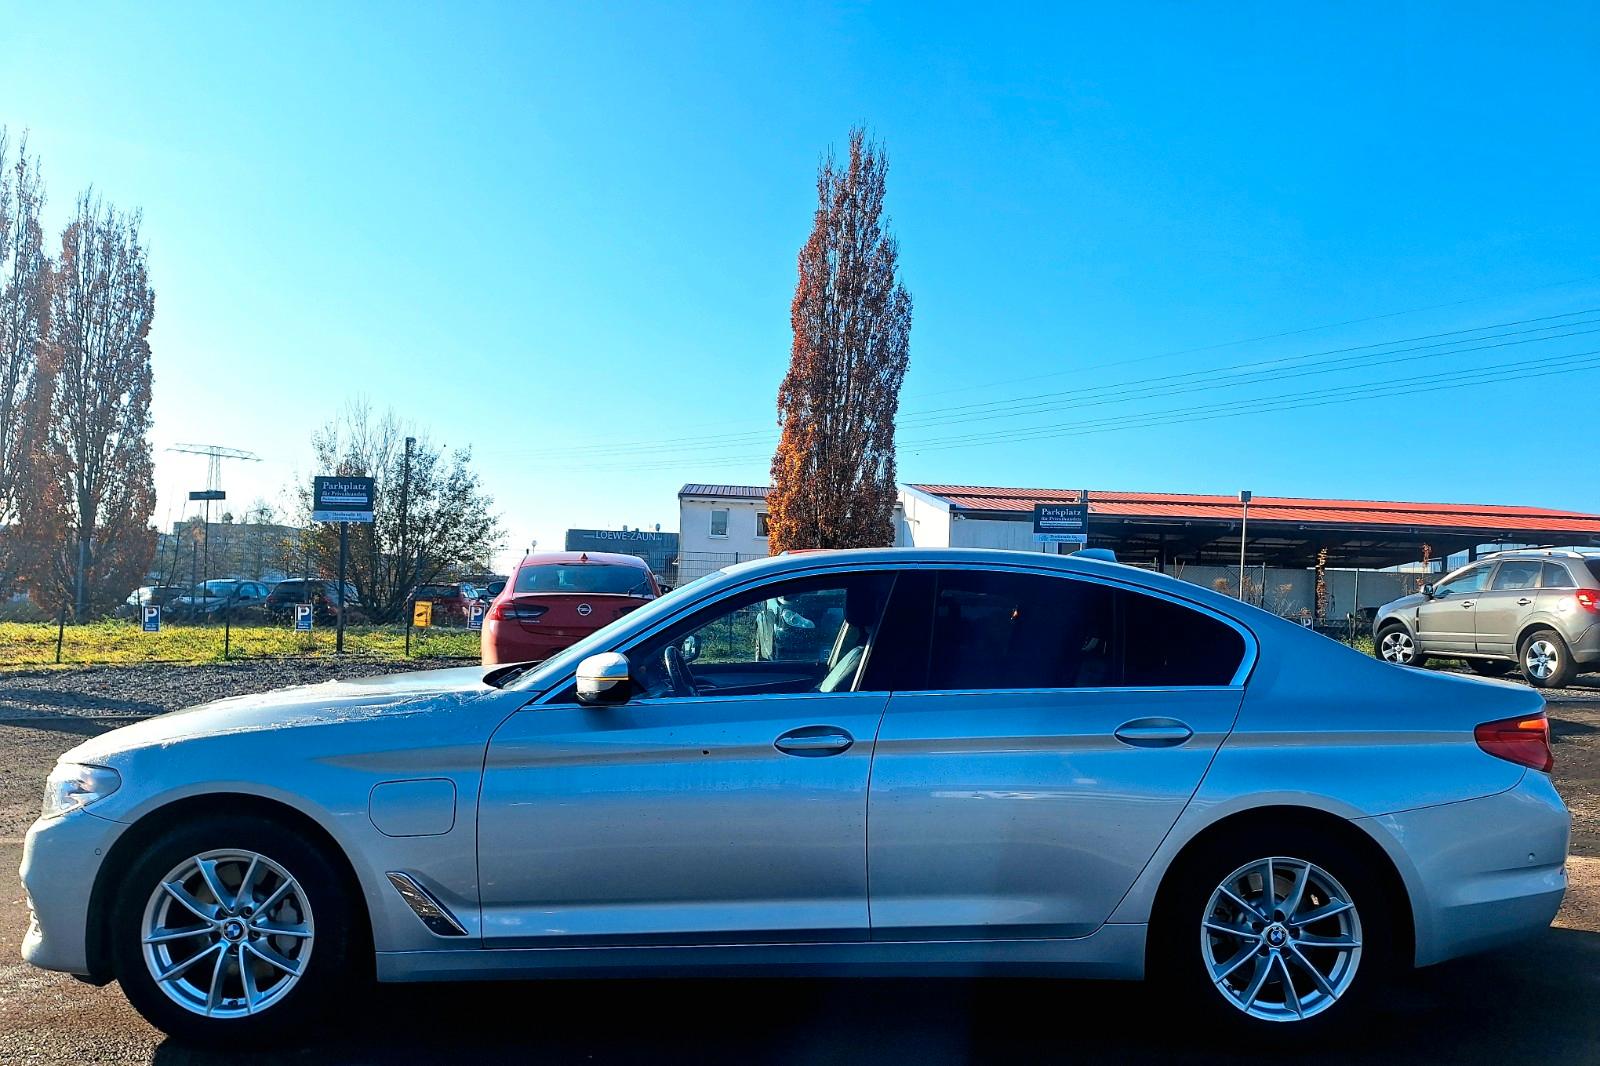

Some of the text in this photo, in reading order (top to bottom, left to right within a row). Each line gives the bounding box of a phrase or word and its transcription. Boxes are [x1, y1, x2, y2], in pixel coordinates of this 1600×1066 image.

[322, 481, 367, 492] Parkplatz
[1041, 508, 1082, 518] Parkplatz
[595, 530, 656, 541] LOEWE-ZAUN
[144, 607, 158, 623] P
[297, 606, 310, 621] P
[471, 606, 482, 621] P
